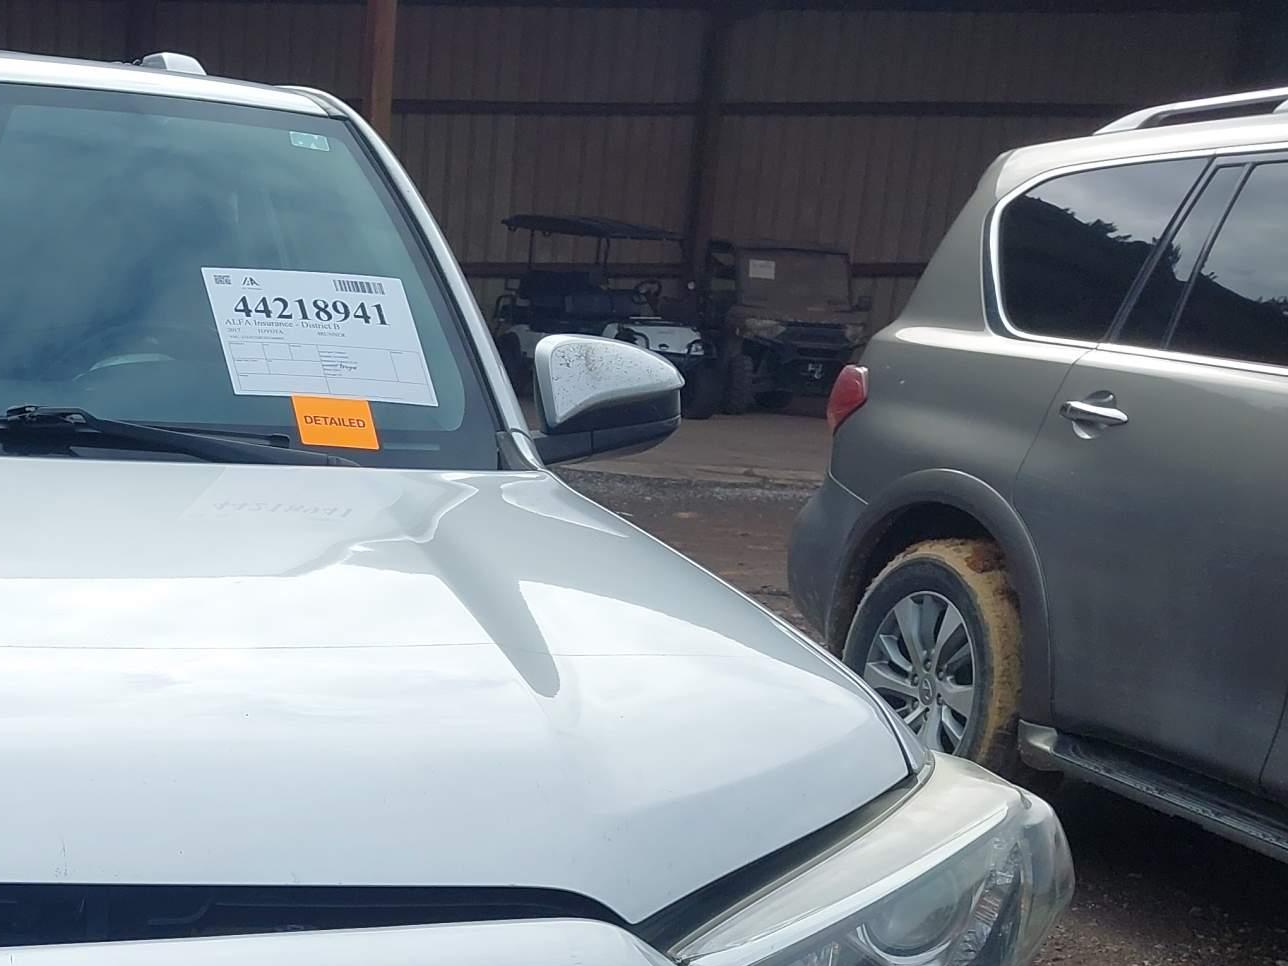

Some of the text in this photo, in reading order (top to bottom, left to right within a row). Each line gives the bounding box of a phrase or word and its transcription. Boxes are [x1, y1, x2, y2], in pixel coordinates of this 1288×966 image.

[234, 295, 390, 326] 44218941
[225, 318, 251, 326] ALFA
[253, 319, 293, 328] Insurance
[301, 321, 332, 330] District
[304, 415, 366, 428] DETAILED
